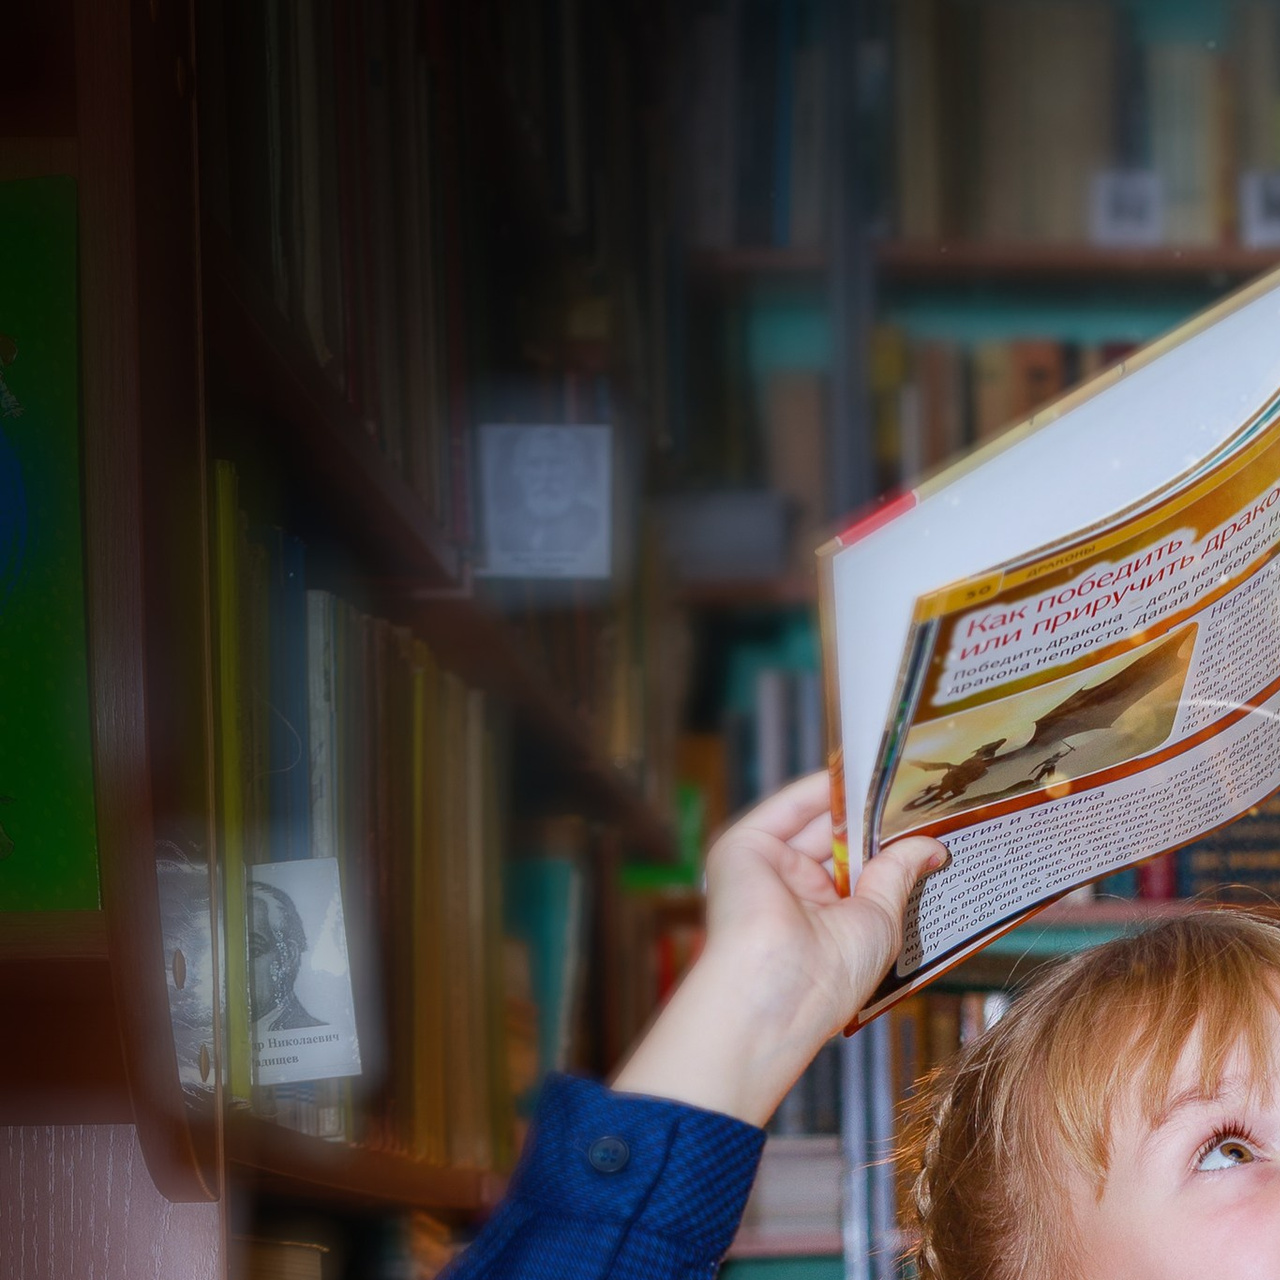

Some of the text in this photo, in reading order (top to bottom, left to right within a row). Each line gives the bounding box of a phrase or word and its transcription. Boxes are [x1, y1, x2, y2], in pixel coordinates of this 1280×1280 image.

[953, 644, 1041, 682] Победить
[1046, 612, 1121, 650] дракона
[1146, 577, 1186, 608] дело
[960, 627, 1021, 661] или
[1032, 549, 1194, 636] приручить
[966, 537, 1181, 639] Как победить
[948, 661, 1029, 696] дракона
[1036, 622, 1128, 666] непросто.
[1134, 591, 1188, 627] Давай
[1030, 790, 1104, 820] тактика
[268, 1032, 340, 1050] Николаевич
